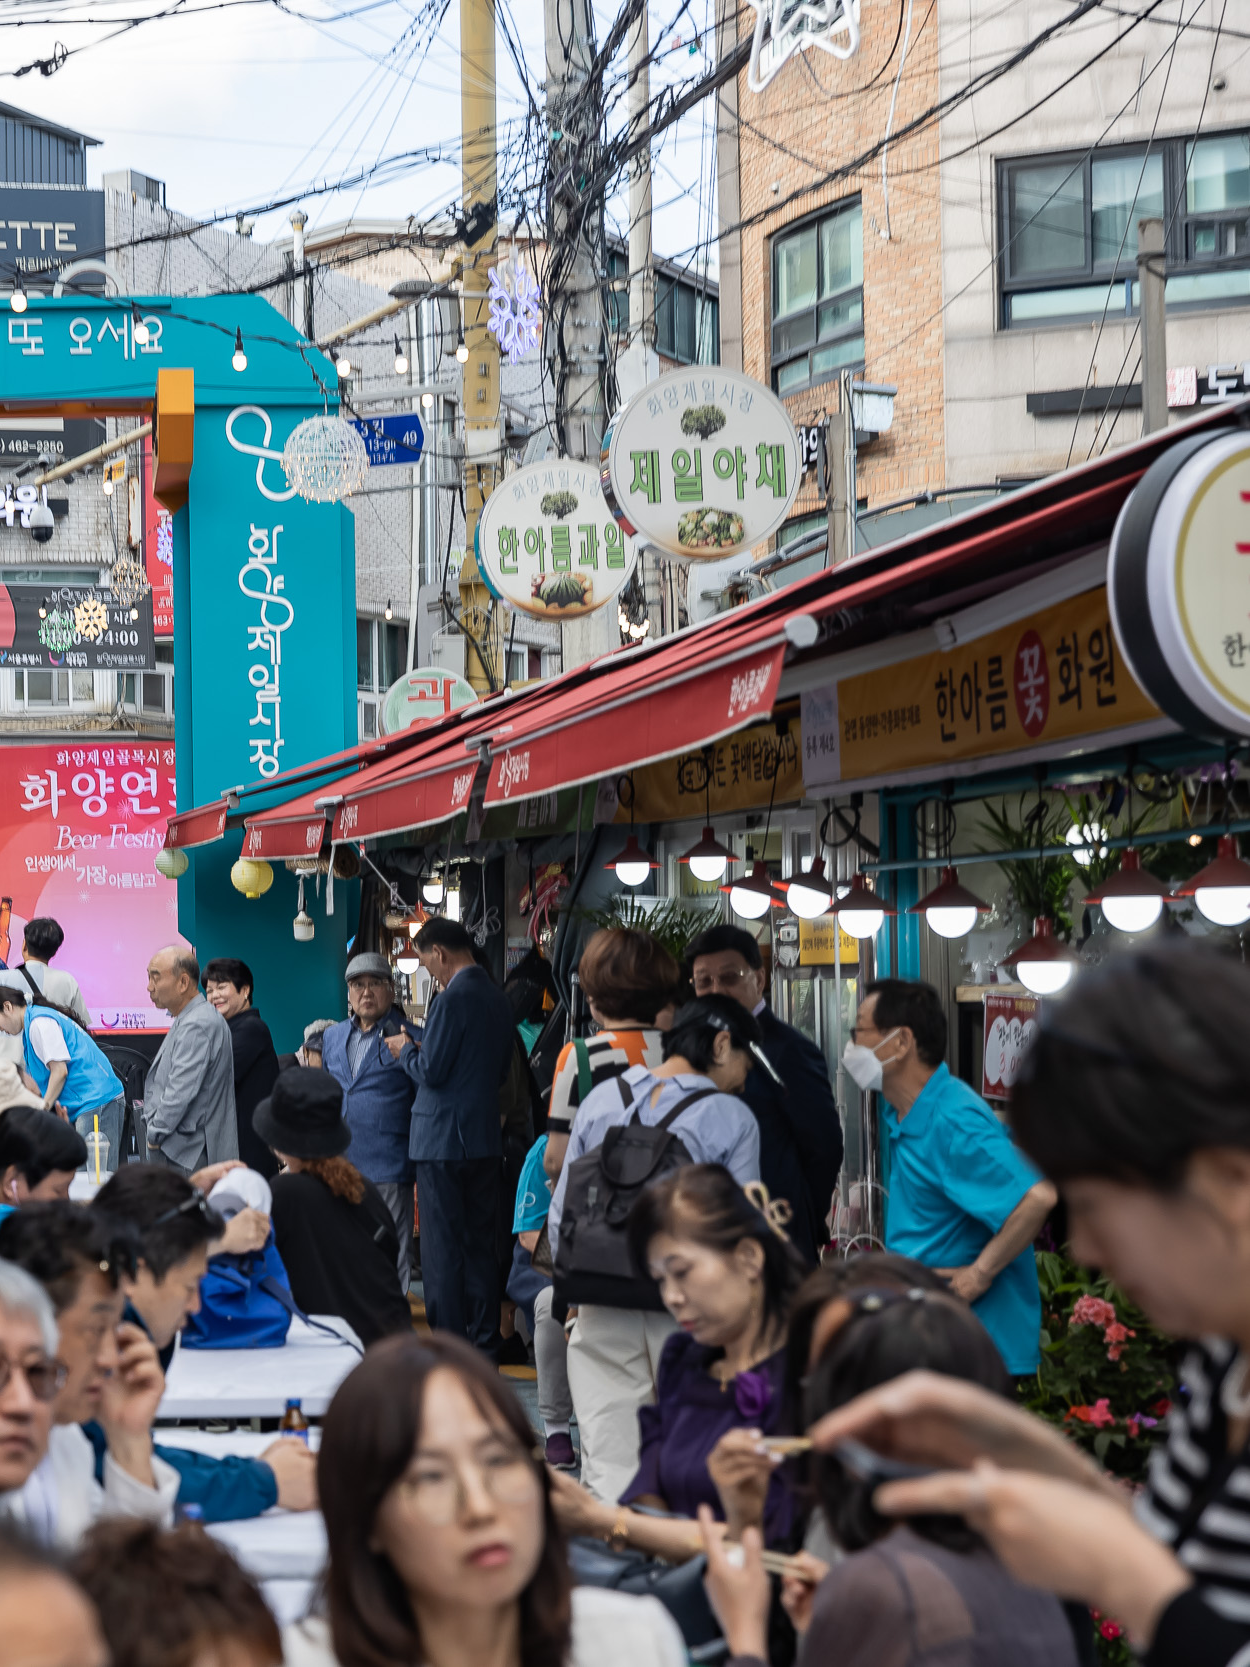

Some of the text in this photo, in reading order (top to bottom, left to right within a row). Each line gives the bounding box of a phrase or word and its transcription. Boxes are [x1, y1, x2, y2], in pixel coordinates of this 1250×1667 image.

[8, 318, 45, 356] 또
[69, 313, 163, 361] 오세요
[1201, 364, 1250, 405] 도
[628, 443, 788, 504] 제일야채
[498, 521, 625, 575] 한아름과일
[238, 522, 295, 779] 화양제일시장
[935, 621, 1118, 743] 한아름 꽃 화원
[19, 766, 176, 819] 화양연
[53, 825, 102, 850] Beer
[24, 855, 76, 874] 인생에서
[76, 864, 108, 886] 가장
[108, 872, 157, 889] 아름답고
